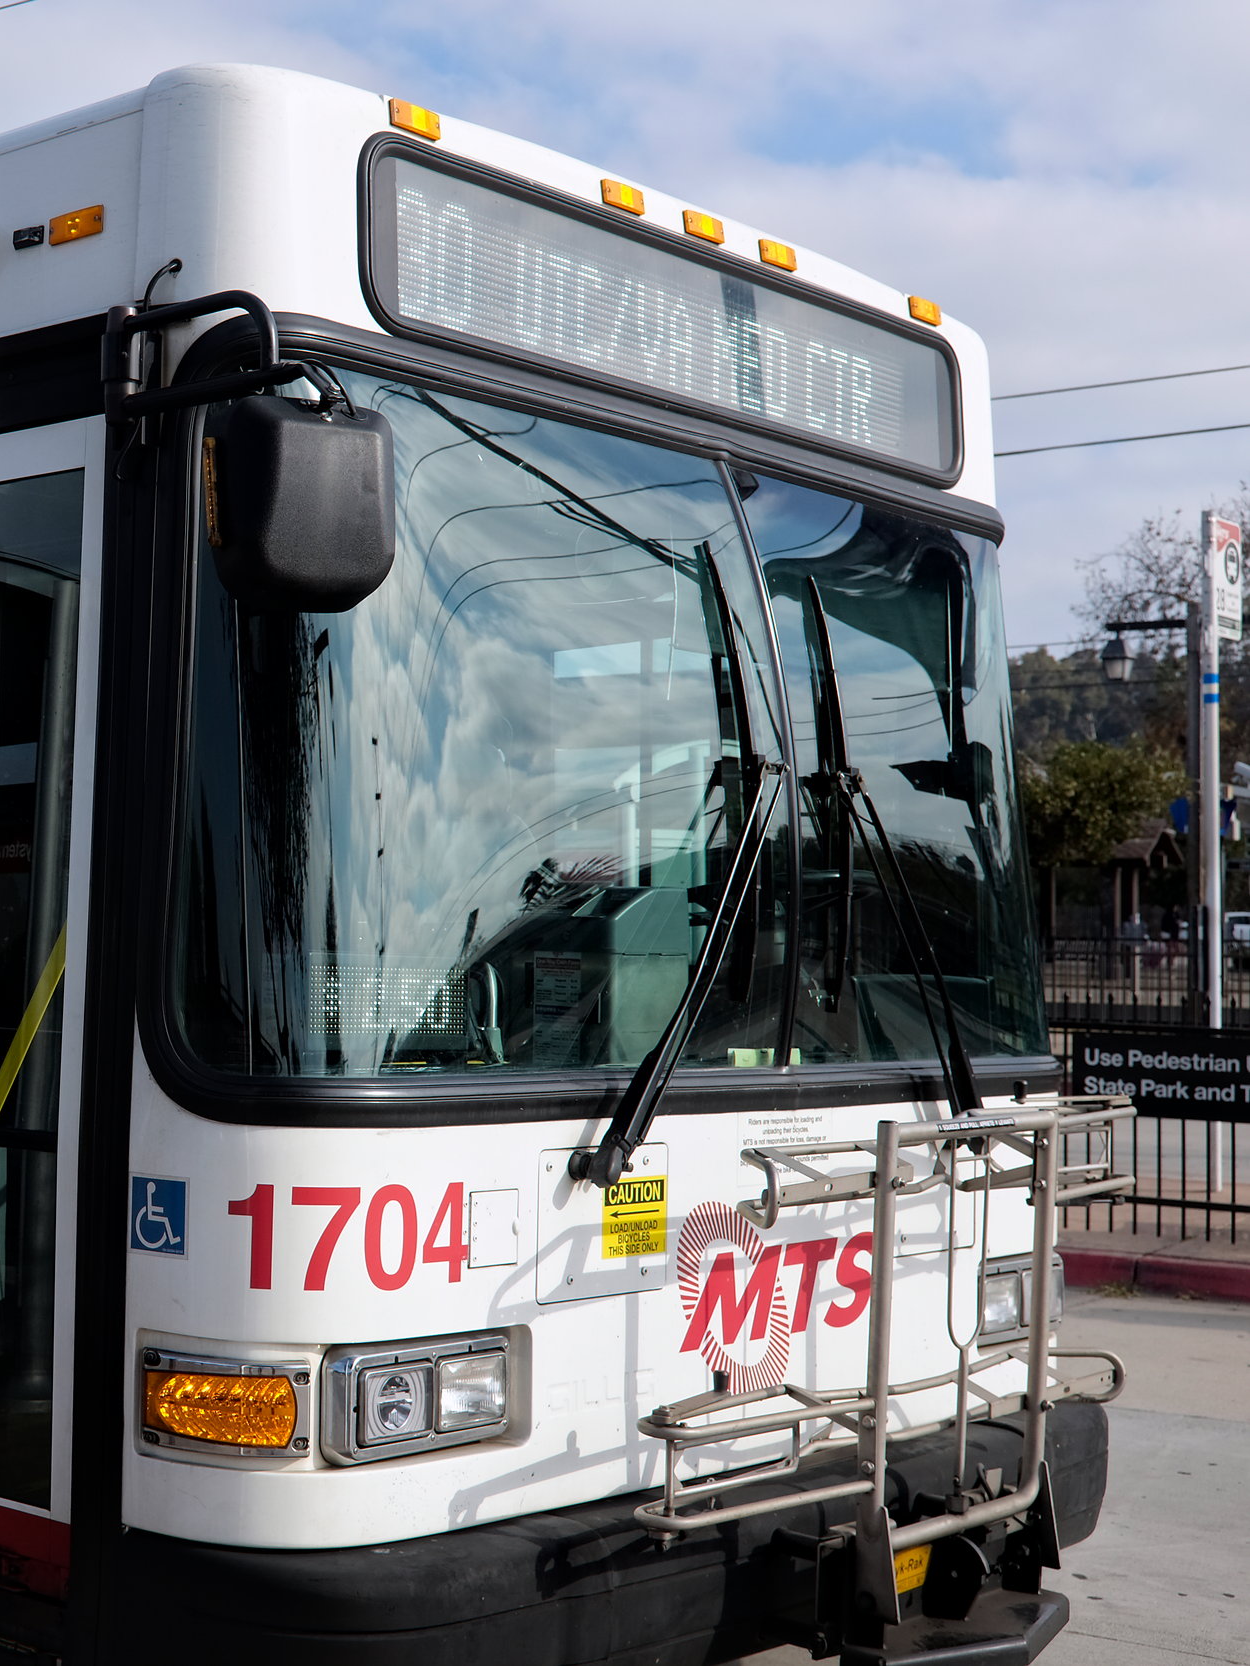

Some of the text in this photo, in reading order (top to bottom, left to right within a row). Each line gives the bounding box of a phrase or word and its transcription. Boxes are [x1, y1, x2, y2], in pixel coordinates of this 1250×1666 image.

[398, 187, 872, 444] 30 UTC/VA MED CTR
[1084, 1047, 1124, 1067] Use
[1127, 1049, 1240, 1073] Pedestrian
[1084, 1075, 1137, 1097] State
[1140, 1078, 1189, 1099] Park
[1194, 1083, 1236, 1103] and
[608, 1181, 661, 1205] CAUTION
[228, 1181, 468, 1291] 1704
[610, 1219, 658, 1234] LOAD/UNLOAD
[617, 1231, 651, 1244] BICYCLES
[608, 1241, 659, 1257] THIS SIDE ONLY
[679, 1231, 873, 1353] MTS
